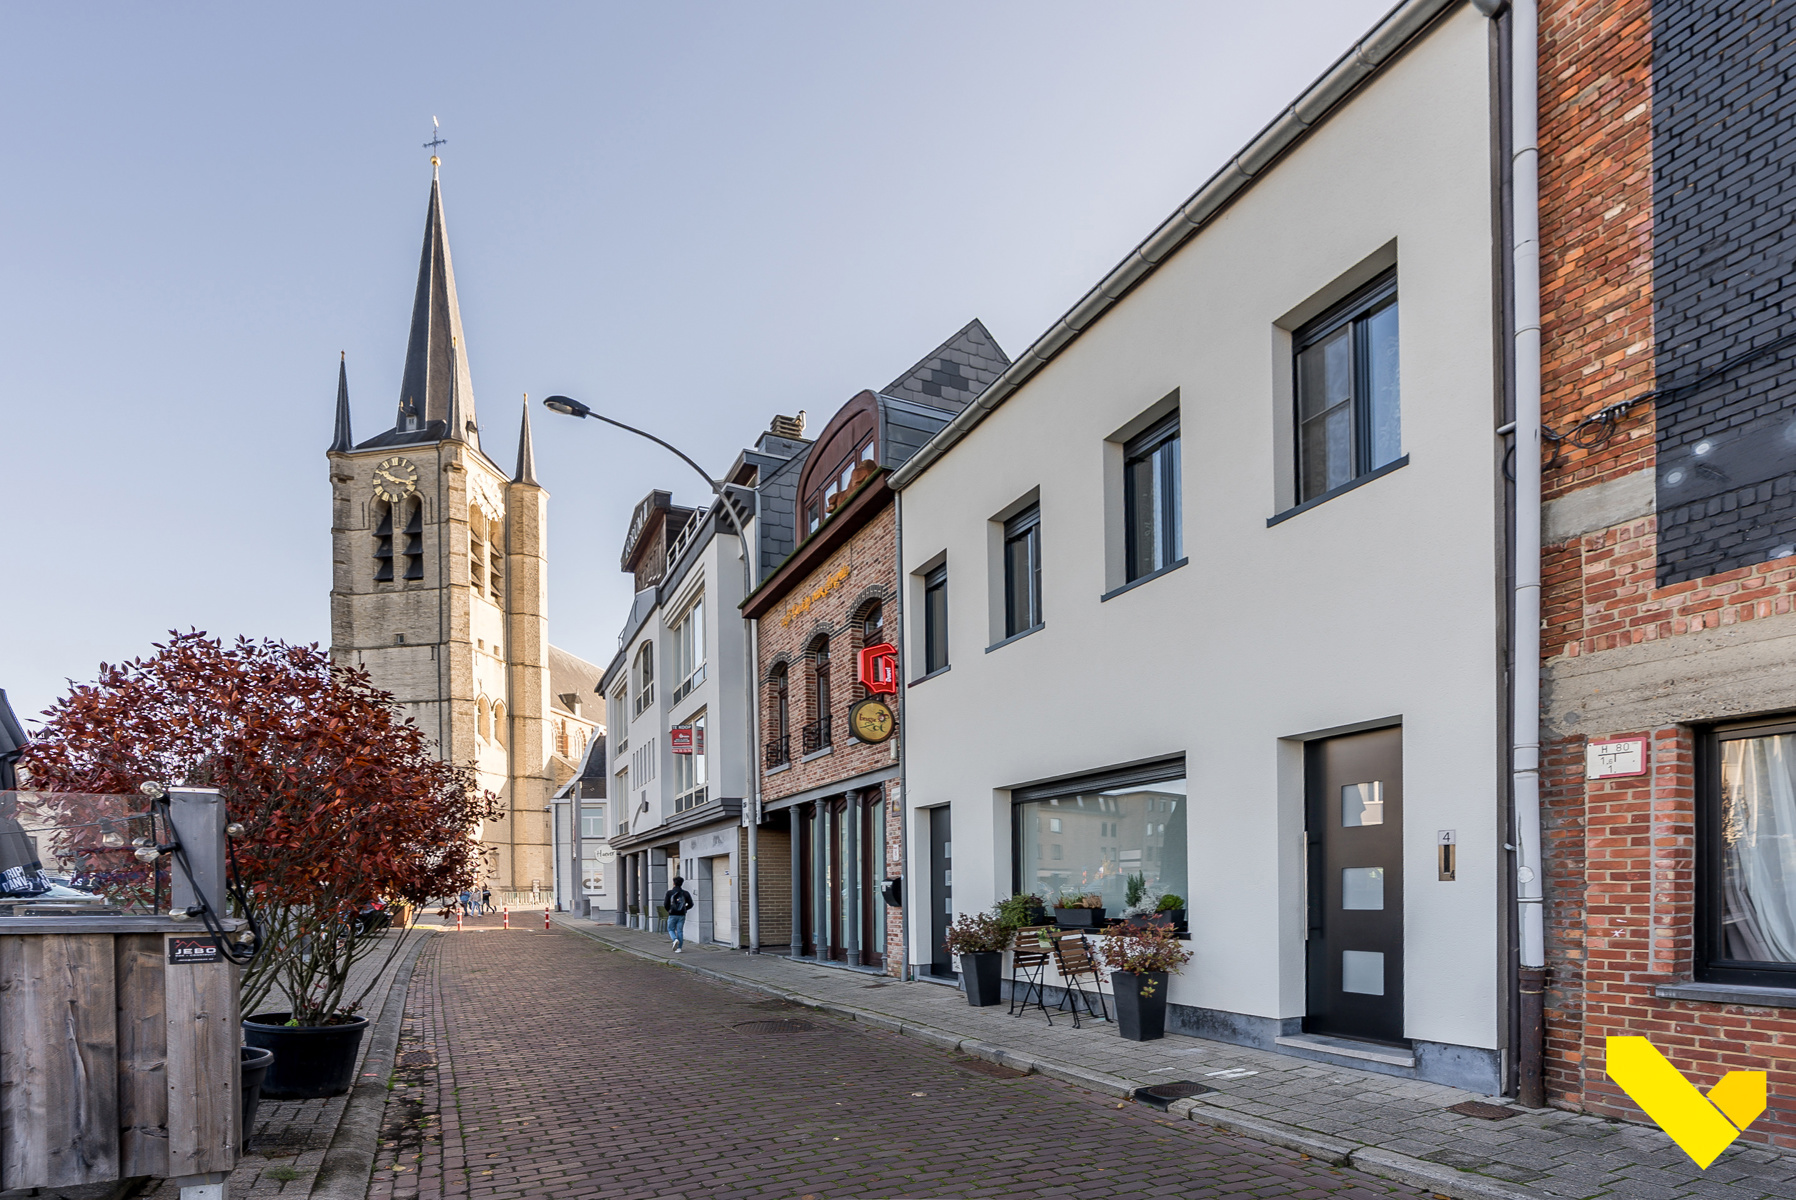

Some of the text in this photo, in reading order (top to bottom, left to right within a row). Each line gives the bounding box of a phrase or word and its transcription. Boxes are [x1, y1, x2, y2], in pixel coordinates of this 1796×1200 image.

[1601, 742, 1630, 754] H 80
[1442, 831, 1451, 843] 4
[1449, 869, 1456, 880] 4
[174, 947, 217, 955] JEBO
